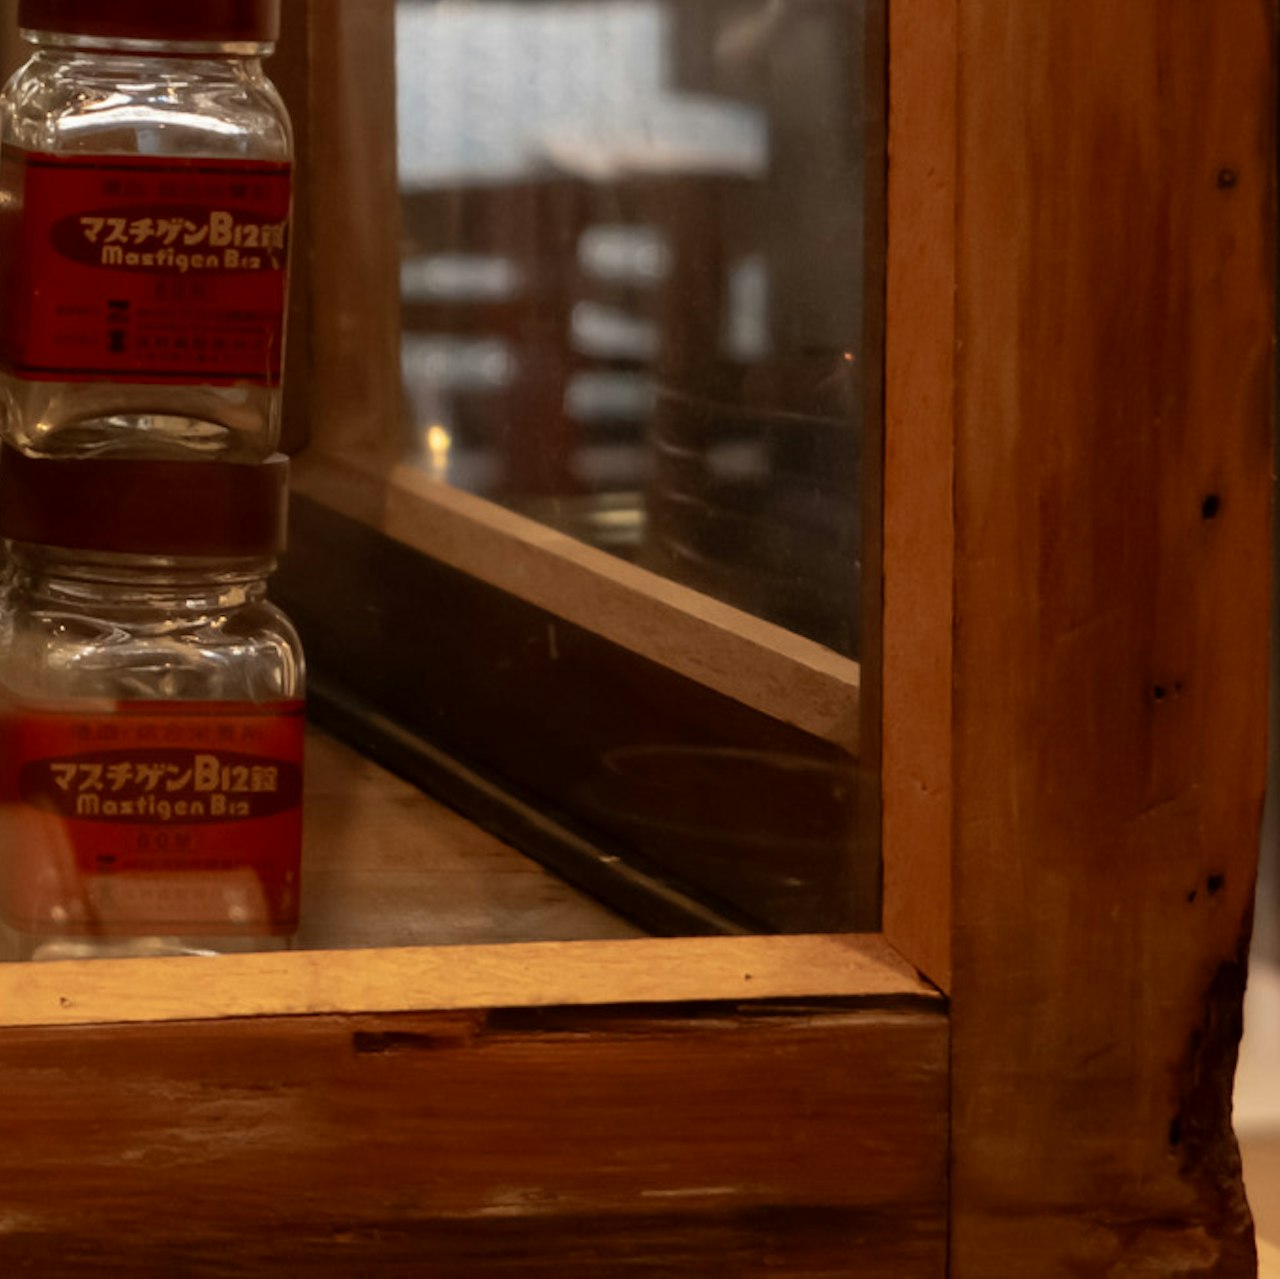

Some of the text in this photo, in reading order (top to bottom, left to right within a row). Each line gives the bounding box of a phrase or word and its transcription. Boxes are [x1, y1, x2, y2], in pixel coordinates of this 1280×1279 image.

[100, 246, 262, 273] Mastigen B12
[75, 793, 251, 820] Mastigen B12
